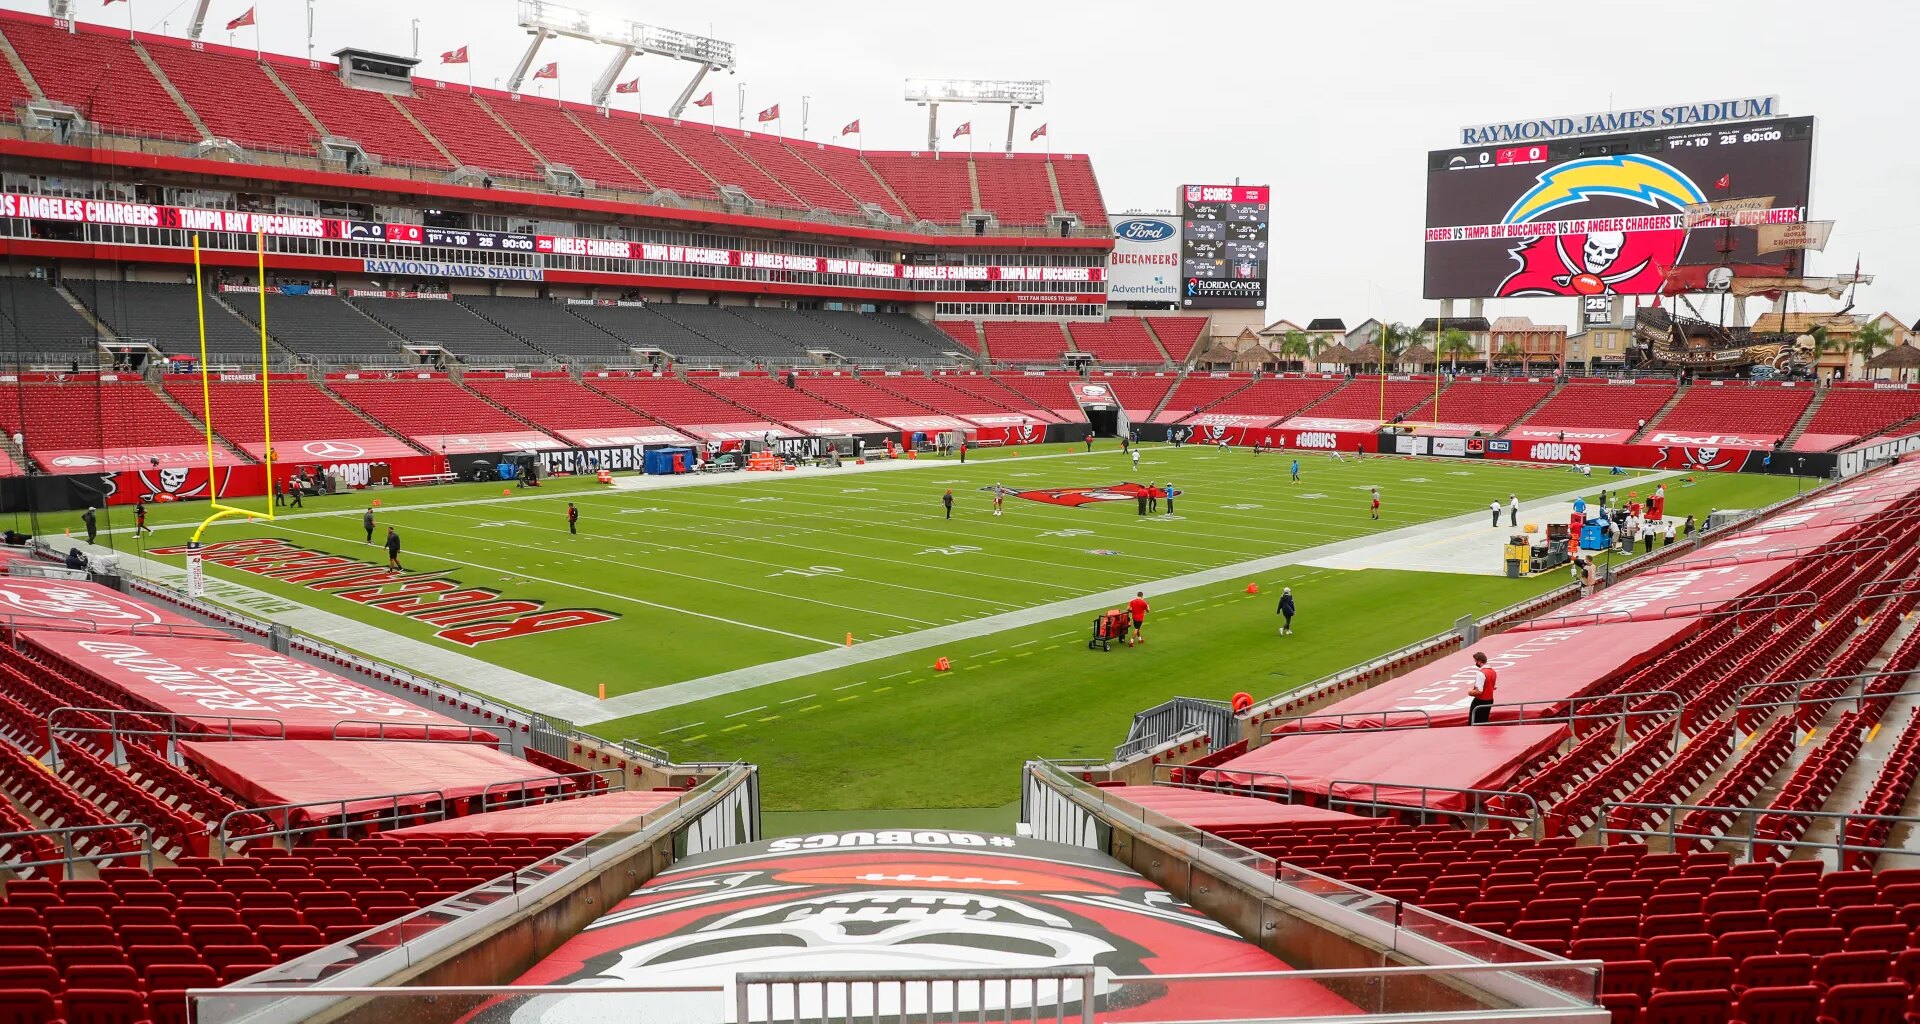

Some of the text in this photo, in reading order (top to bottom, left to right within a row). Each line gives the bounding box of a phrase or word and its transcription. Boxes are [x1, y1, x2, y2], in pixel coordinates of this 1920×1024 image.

[54, 19, 68, 28] 313
[191, 41, 204, 49] 312
[309, 60, 321, 68] 311
[1463, 97, 1773, 144] RAYMOND JAMES STADIUM
[1720, 134, 1736, 145] 25
[1743, 130, 1781, 143] 90:00
[1670, 140, 1684, 149] 1ST
[1695, 138, 1709, 147] 10
[1479, 152, 1490, 163] 0
[1529, 148, 1540, 159] 0
[1203, 187, 1232, 201] SCORES
[19, 198, 84, 221] ANGELES
[86, 201, 158, 226] CHARGERS
[161, 207, 177, 227] VS
[180, 209, 222, 231] TAMPA
[225, 212, 248, 232] BAY
[251, 214, 323, 237] BUCCANEERS
[326, 219, 339, 238] VS
[1453, 228, 1463, 239] VS
[1464, 226, 1489, 239] TAMPA
[1491, 225, 1506, 237] BAY
[1507, 223, 1556, 237] BUCCANEERS
[1558, 221, 1569, 234] VS
[1569, 220, 1585, 233] LOS
[1587, 218, 1624, 233] ANGELES
[1626, 216, 1671, 230] CHARGERS
[1673, 216, 1683, 228] VS
[1739, 209, 1799, 225] BUCCANEERS
[371, 225, 381, 236] 0
[408, 228, 418, 238] 0
[1126, 222, 1163, 238] Ford
[428, 234, 443, 243] 1ST
[454, 236, 468, 245] 10
[479, 237, 493, 247] 25
[502, 239, 533, 249] 90:00
[539, 240, 552, 249] 25
[1773, 238, 1817, 246] CHAMPIONS
[586, 239, 630, 257] CHARGERS
[631, 244, 641, 258] VS
[642, 245, 668, 261] TAMPA
[670, 248, 685, 262] BAY
[686, 248, 729, 265] BUCCANEERS
[730, 251, 739, 265] VS
[740, 252, 753, 266] LOS
[755, 253, 783, 268] ANGELES
[784, 255, 816, 271] CHARGERS
[818, 258, 826, 272] VS
[827, 260, 846, 273] TAMPA
[847, 261, 859, 274] BAY
[860, 262, 894, 277] BUCCANEERS
[903, 267, 913, 278] LOS
[914, 266, 947, 279] ANGELES
[948, 267, 987, 279] CHARGERS
[989, 267, 998, 279] VS
[1000, 267, 1025, 280] TAMPA
[1026, 268, 1041, 280] BAY
[1043, 268, 1089, 280] BUCCANEERS
[1090, 268, 1100, 280] VS
[1112, 252, 1178, 266] BUCCANEERS
[366, 260, 543, 280] RAYMOND JAMES STADIUM
[1111, 284, 1177, 293] AdventHealth
[1198, 280, 1260, 289] FLORIDA CANCER
[1586, 298, 1605, 310] 25
[220, 373, 257, 381] BUCCANEERS
[1296, 432, 1337, 448] #GOBUCS
[1522, 430, 1605, 439] verzon
[1650, 433, 1766, 447] FedEx
[1468, 441, 1481, 450] 25
[1530, 443, 1582, 461] #GOBUCS
[783, 565, 844, 577] 10
[236, 596, 303, 614] END
[77, 640, 280, 712] RAYMOND
[198, 667, 356, 716] JAMES
[225, 652, 427, 720] STADIUM
[767, 830, 1016, 853] #GOBUCS
